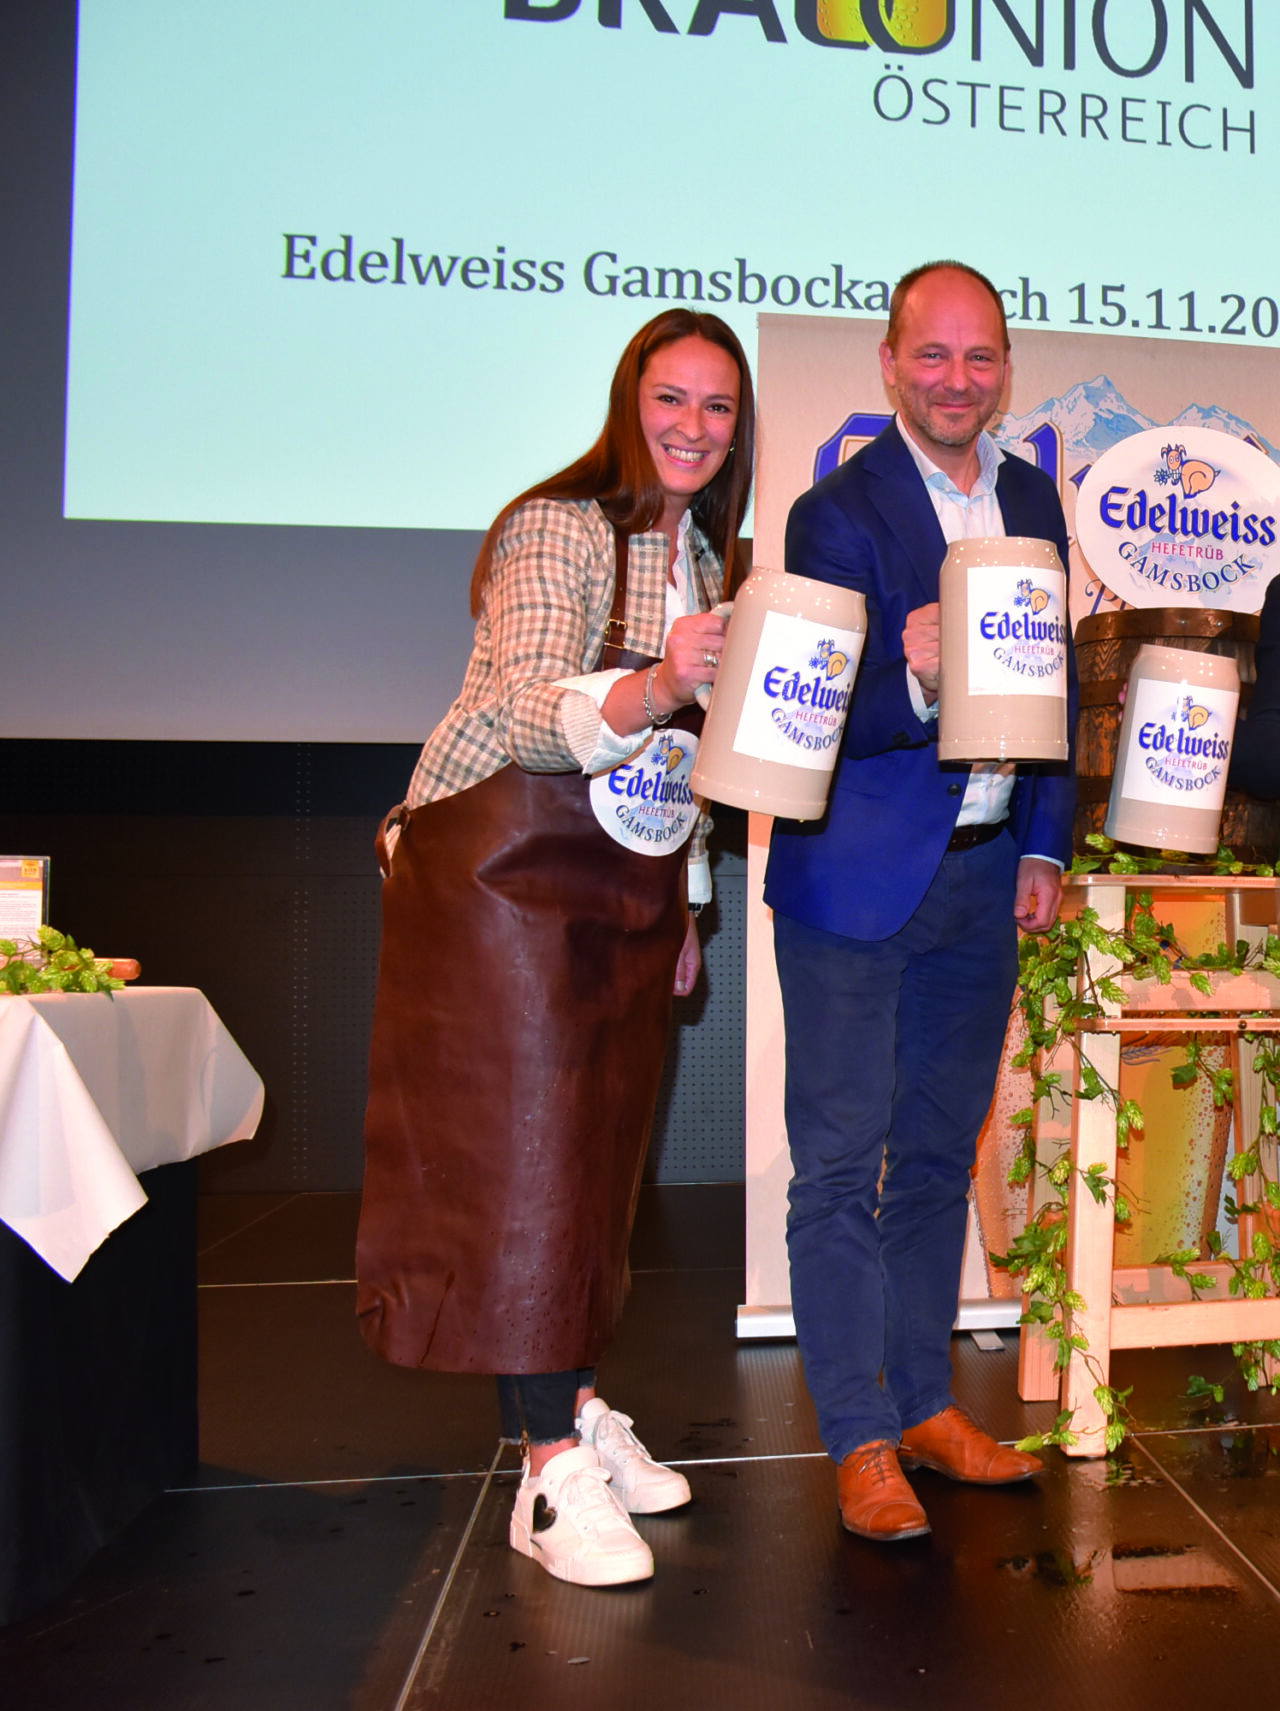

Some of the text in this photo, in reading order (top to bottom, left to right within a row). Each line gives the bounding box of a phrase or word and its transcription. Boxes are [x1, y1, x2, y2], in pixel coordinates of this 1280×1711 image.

[873, 64, 1257, 154] ÖSTERREICH
[280, 232, 566, 294] Edelweiss
[1099, 485, 1277, 547] Edelweiss
[1118, 541, 1256, 593] GAMSBOCK
[1151, 541, 1224, 561] HEFETRÜB
[993, 650, 1065, 678] GAMSBOCK
[1014, 644, 1055, 656] HEFETRÜB
[795, 711, 839, 727] HEFETRÜB
[1138, 722, 1230, 761] Edelweiss
[1145, 756, 1221, 792] GAMSBOCK
[1164, 757, 1208, 771] HEFETRÜB
[607, 763, 694, 806] Edelweiss
[615, 804, 688, 843] GAMSBOCK
[638, 806, 676, 819] HEFETRÜB
